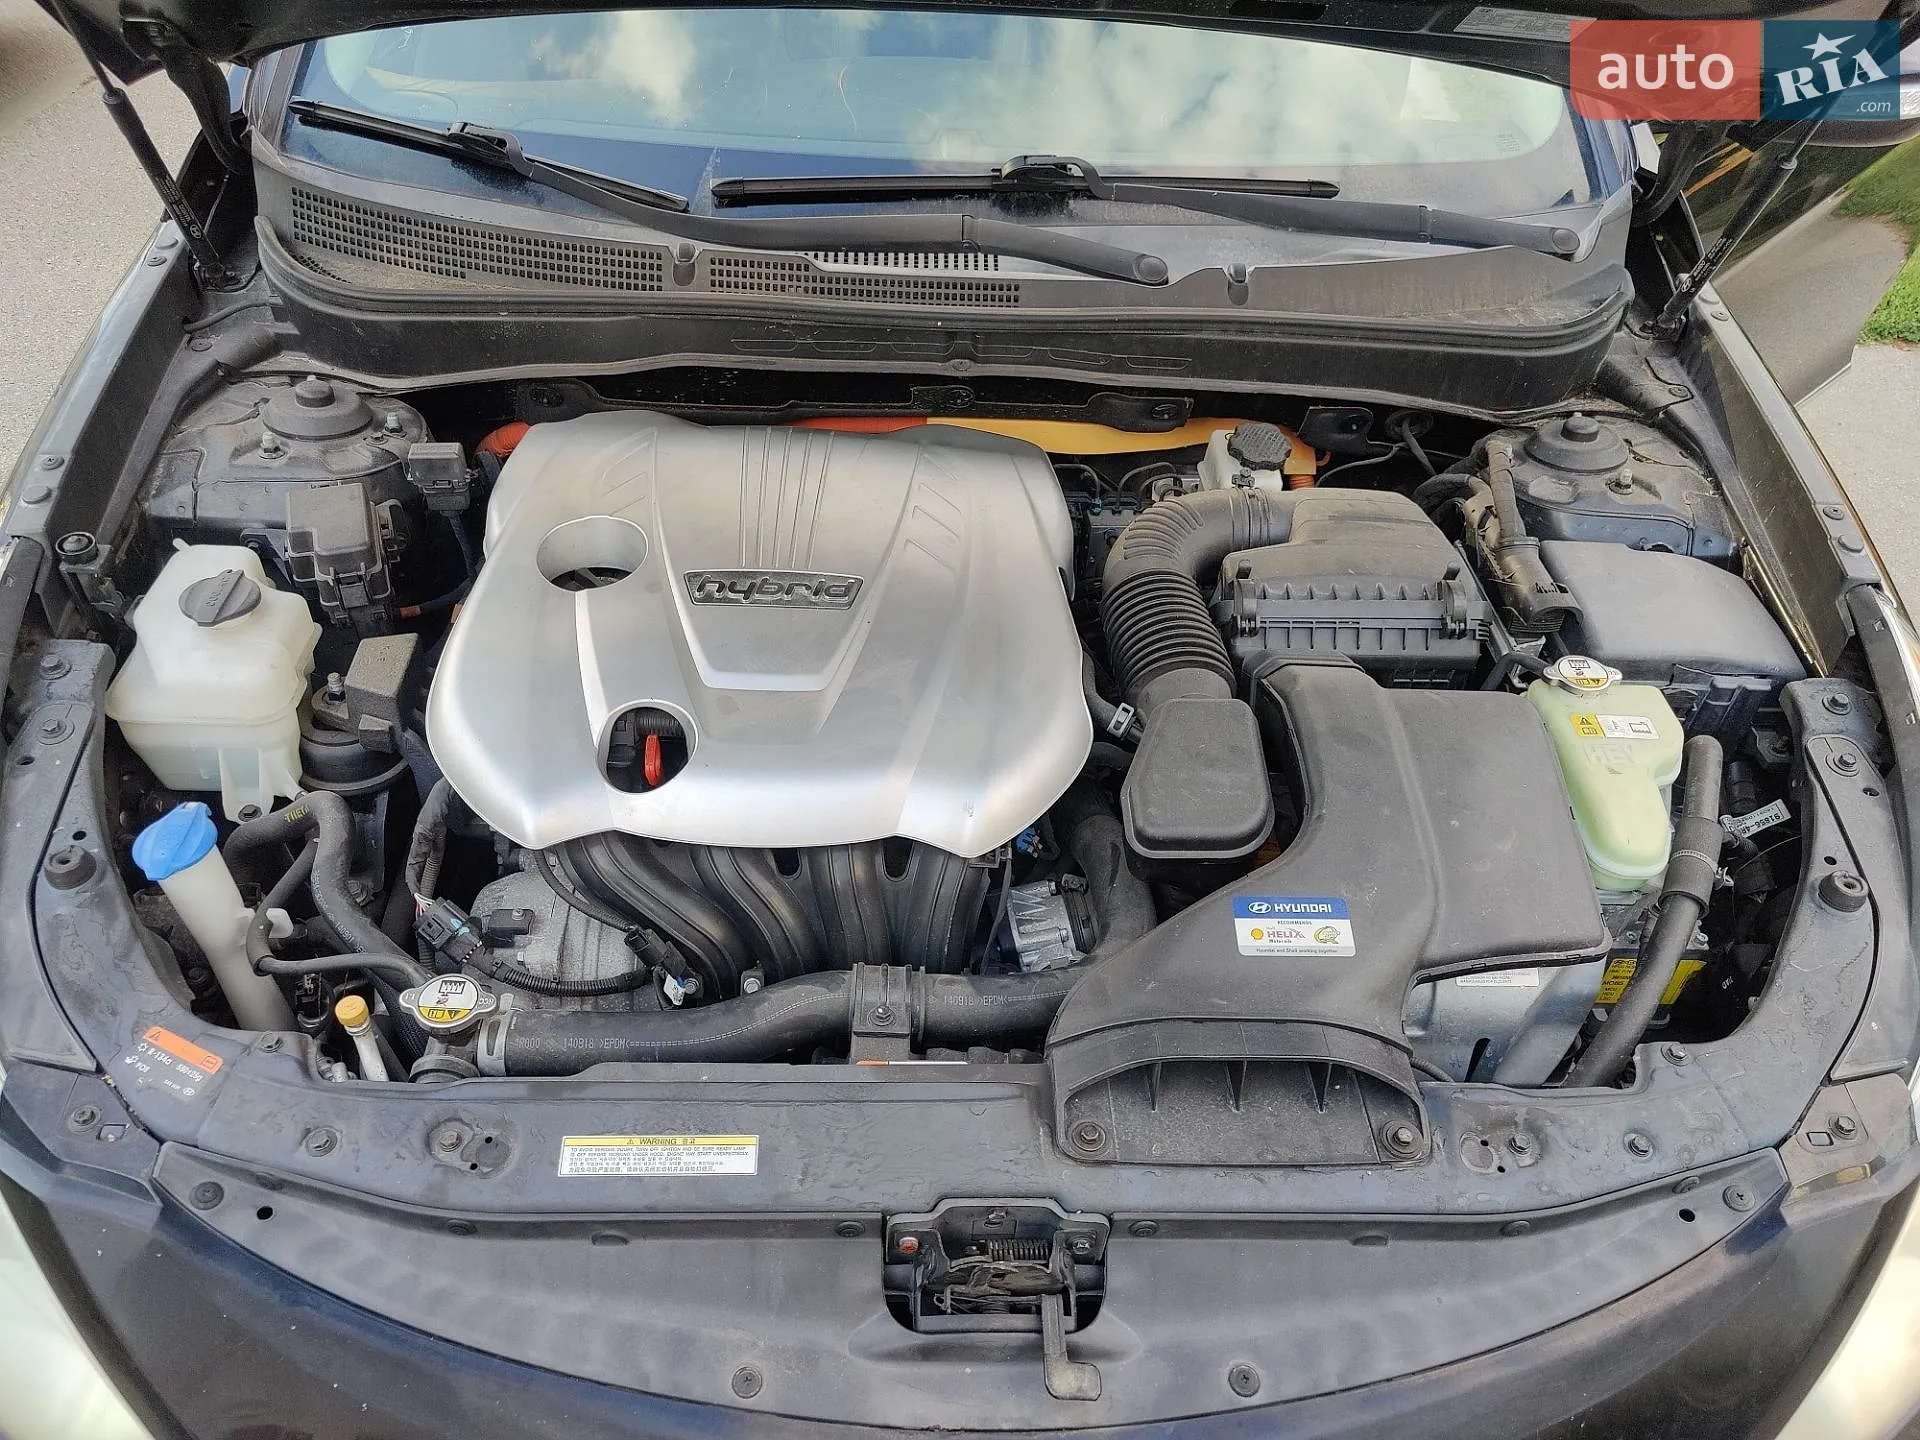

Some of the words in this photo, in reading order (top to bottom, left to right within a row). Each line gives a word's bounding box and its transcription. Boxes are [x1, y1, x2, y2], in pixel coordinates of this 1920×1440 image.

[695, 574, 856, 603] hybrid
[1274, 903, 1333, 913] HYUNDAI
[1266, 926, 1307, 939] HELIX
